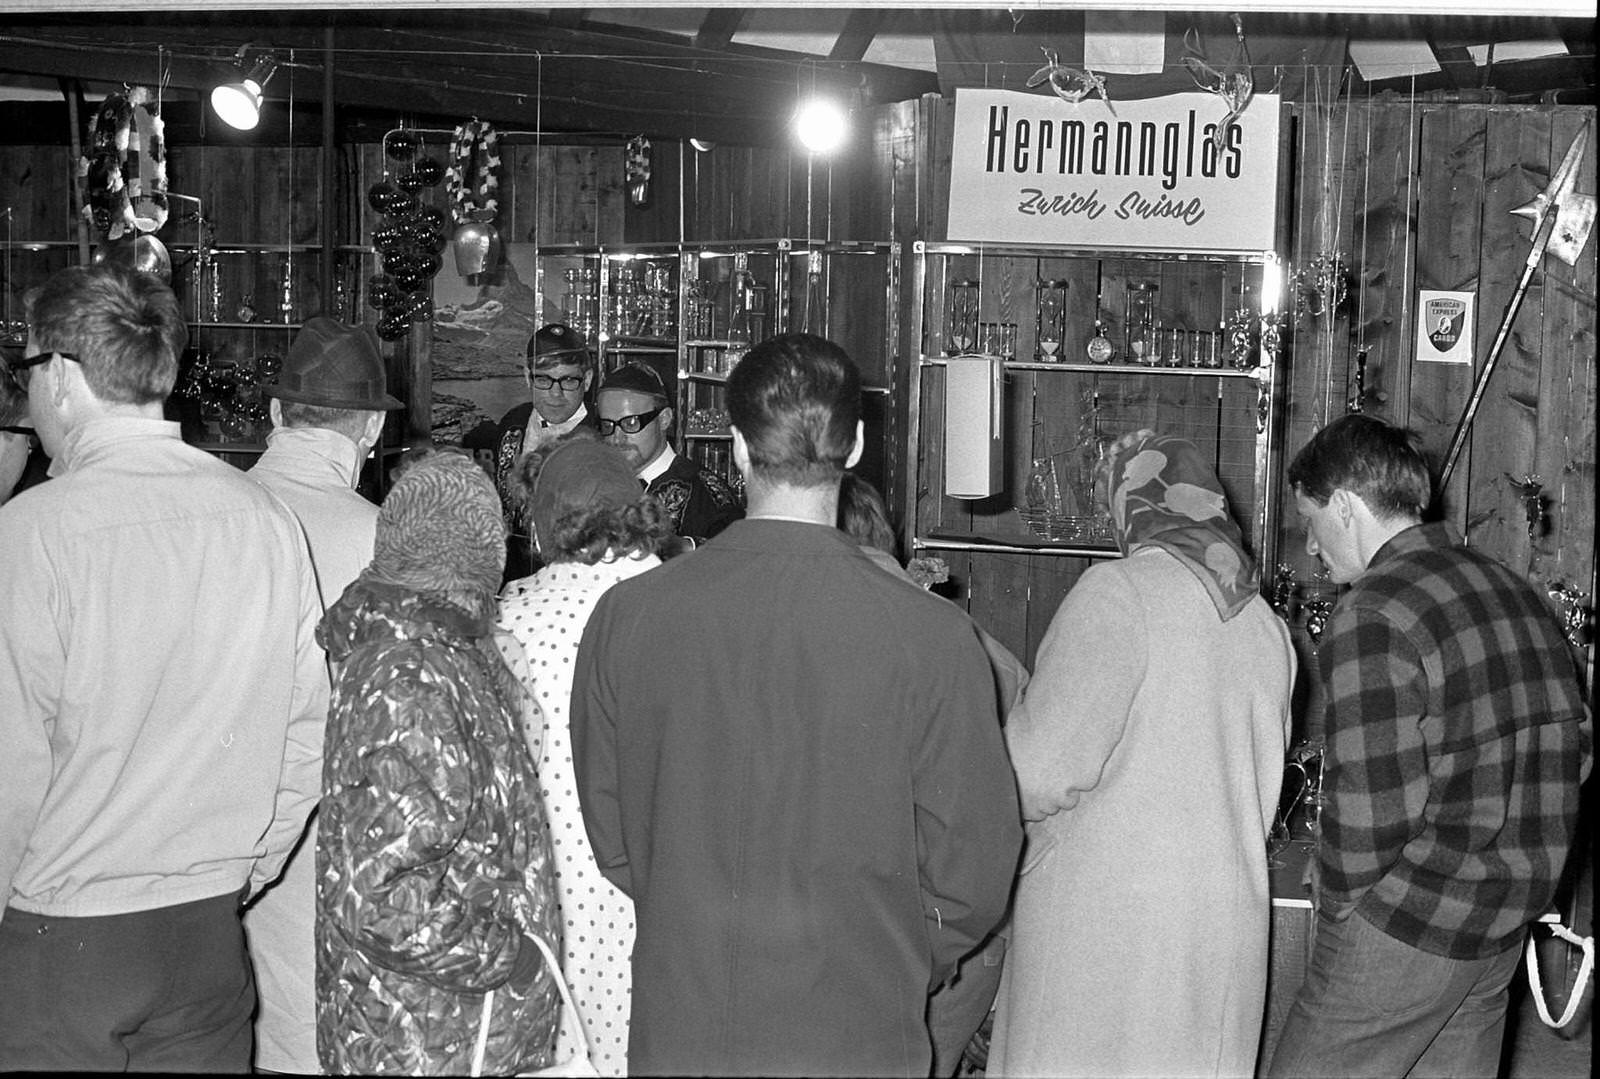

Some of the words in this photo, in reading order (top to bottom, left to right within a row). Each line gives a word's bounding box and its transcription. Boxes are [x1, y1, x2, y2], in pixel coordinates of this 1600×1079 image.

[985, 105, 1243, 190] Hermannglas
[1017, 187, 1106, 220] Zurich
[1114, 190, 1205, 226] Suisse
